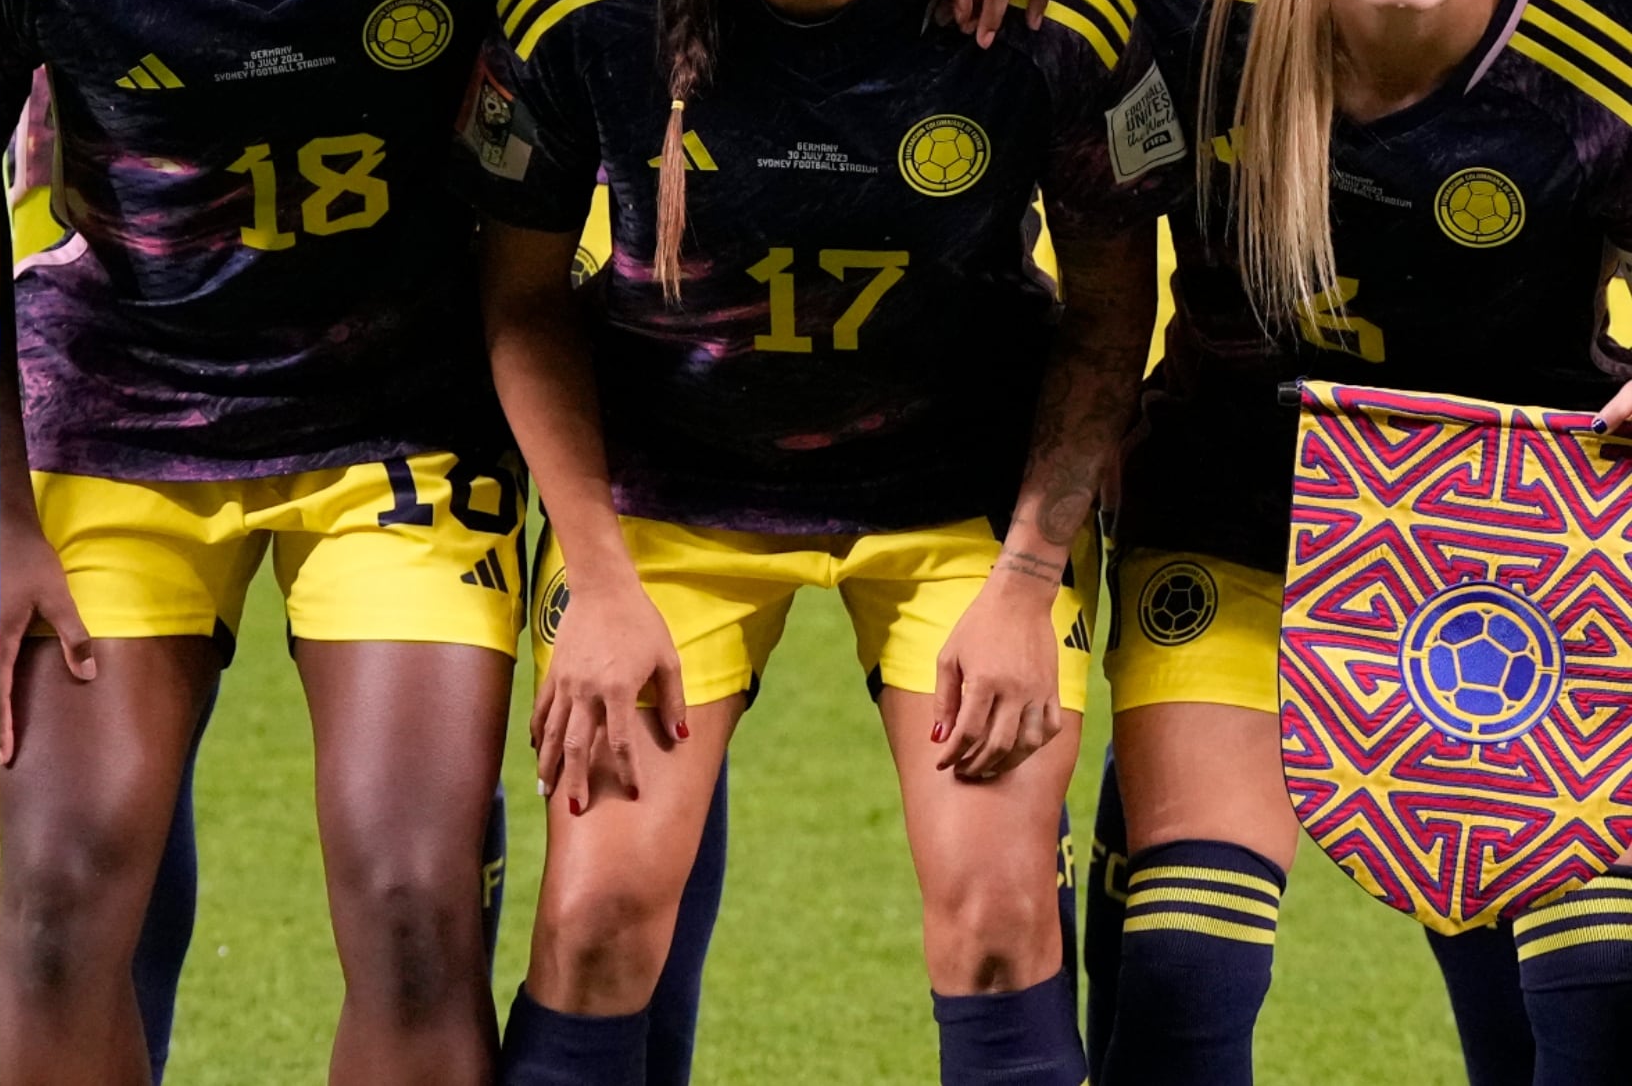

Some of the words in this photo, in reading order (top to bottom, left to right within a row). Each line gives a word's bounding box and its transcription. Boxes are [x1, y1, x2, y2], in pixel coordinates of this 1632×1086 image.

[242, 60, 255, 70] 30
[257, 57, 279, 68] JULY
[280, 52, 304, 64] 2023
[250, 45, 292, 60] GERMANY
[214, 70, 248, 82] SYDNEY
[250, 64, 295, 77] FOOTBALL
[296, 56, 336, 71] STADIUM
[797, 141, 838, 153] GERMANY
[787, 150, 800, 160] 30
[801, 151, 824, 160] JULY
[825, 152, 848, 163] 2023
[757, 158, 791, 168] SYDNEY
[793, 160, 837, 170] FOOTBALL
[839, 163, 878, 174] STADIUM
[227, 132, 390, 251] 18
[747, 248, 910, 354] 17
